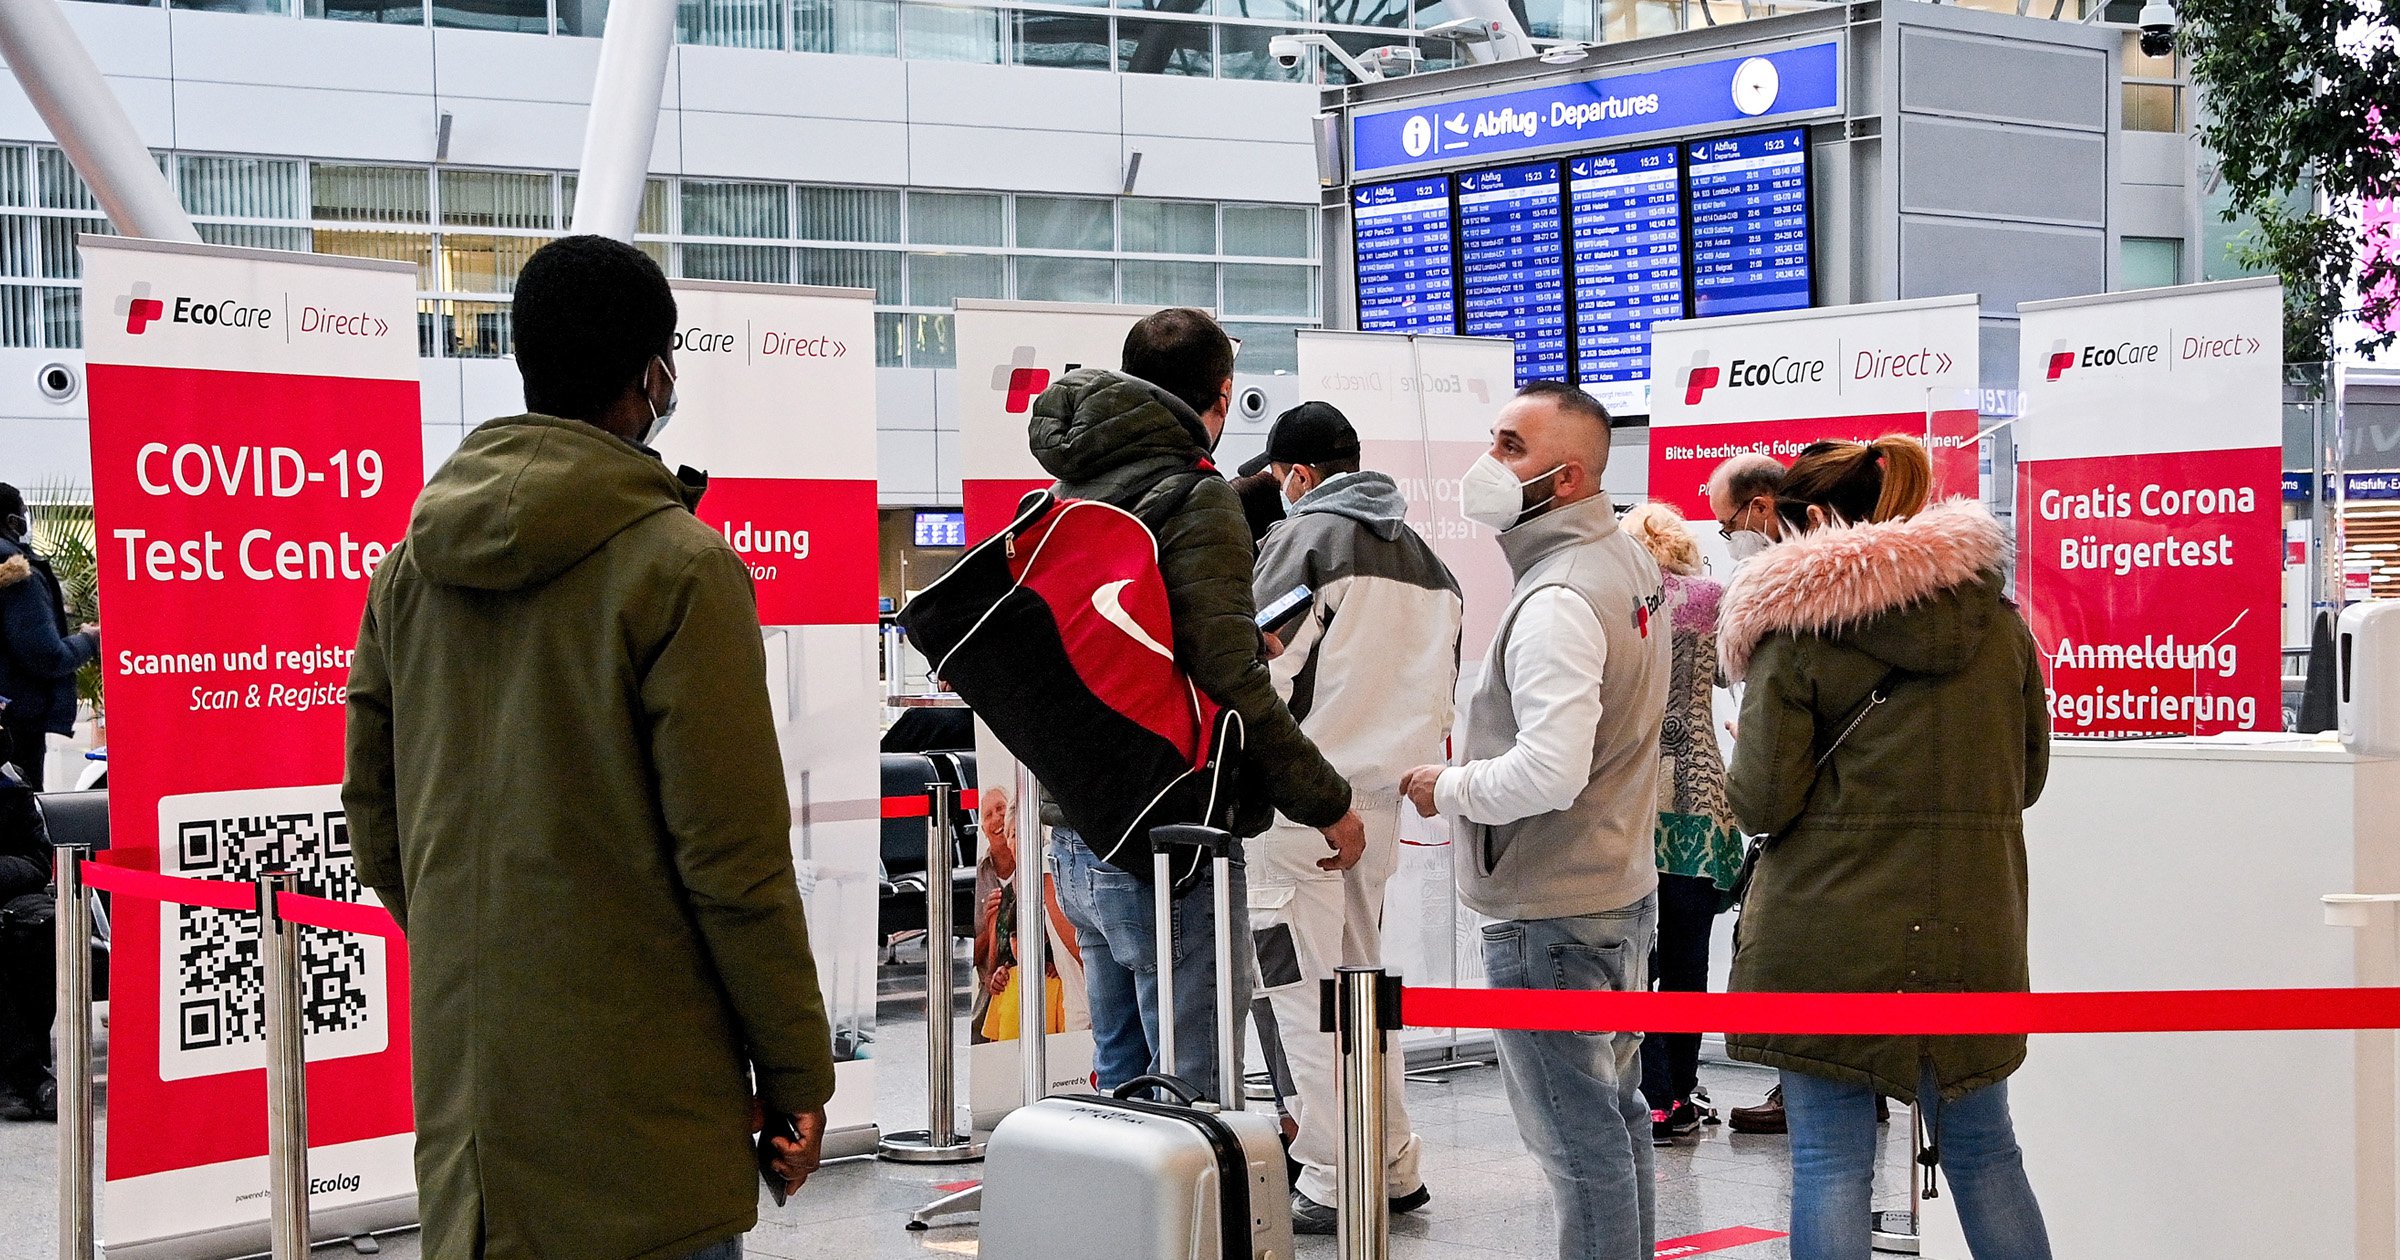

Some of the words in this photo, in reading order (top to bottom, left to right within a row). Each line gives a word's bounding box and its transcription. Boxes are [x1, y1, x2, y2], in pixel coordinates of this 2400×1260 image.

[1473, 107, 1537, 138] Abflug
[1551, 93, 1659, 130] Departures
[1593, 156, 1615, 169] Abflug
[1640, 156, 1659, 167] 15:23
[1667, 152, 1673, 163] 3
[1714, 140, 1737, 153] Abflug
[1764, 139, 1784, 150] 15:23
[1793, 136, 1799, 146] 4
[1374, 186, 1394, 197] Abflug
[1416, 186, 1432, 196] 15:23
[1440, 183, 1444, 192] 1
[1480, 171, 1501, 183] Abflug
[1524, 171, 1542, 181] 15:23
[1549, 168, 1555, 178] 2
[173, 297, 272, 329] EcoCare
[301, 306, 369, 336] Direct
[672, 327, 734, 353] oCare
[763, 332, 828, 357] Direct
[2081, 342, 2159, 368] EcoCare
[2182, 333, 2243, 360] Direct
[1728, 355, 1824, 388] EcoCare
[1855, 347, 1931, 380] Direct
[1665, 446, 1694, 461] Bitte
[1697, 443, 1749, 460] beachten
[1752, 441, 1770, 456] Sie
[136, 442, 384, 499] COVID-19
[2349, 478, 2387, 490] Ausfuhr
[2039, 483, 2132, 521] Gratis
[2139, 484, 2256, 517] Corona
[113, 529, 225, 581] Test
[239, 528, 405, 581] Cente
[724, 520, 810, 560] ldung
[2060, 533, 2234, 576] Bürgertest
[119, 649, 217, 676] Scannen
[223, 644, 268, 672] und
[276, 643, 355, 675] registr
[2054, 634, 2237, 678] Anmeldung
[189, 686, 239, 711] Scan
[244, 683, 261, 708] &
[267, 681, 348, 712] Registe
[2045, 685, 2257, 730] Registrierung
[1052, 1077, 1079, 1089] powered
[1079, 1076, 1087, 1086] by
[310, 1172, 361, 1195] Ecolog
